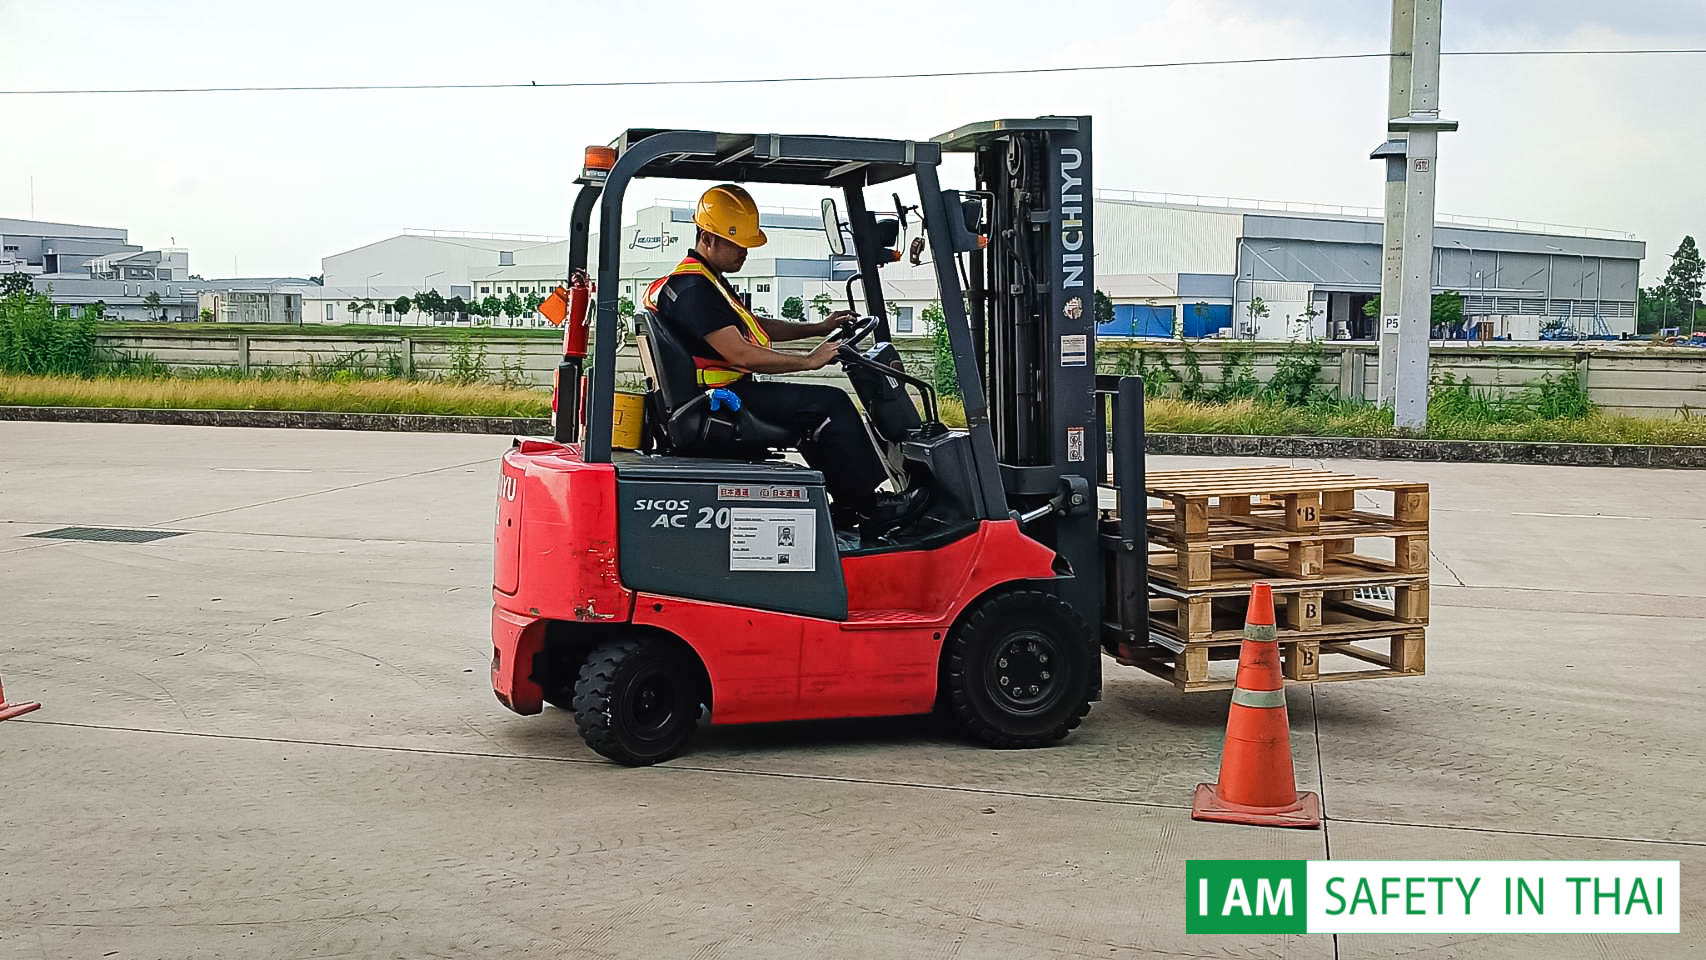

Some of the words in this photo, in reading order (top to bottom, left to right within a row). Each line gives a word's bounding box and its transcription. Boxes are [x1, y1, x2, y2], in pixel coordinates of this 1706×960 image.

[1061, 148, 1083, 289] NICHIYU
[1386, 318, 1399, 328] P5
[633, 499, 690, 511] SICOS
[650, 514, 688, 528] AC
[695, 507, 730, 529] 20
[1304, 506, 1316, 521] B
[1306, 604, 1317, 618] B
[1303, 651, 1314, 666] B
